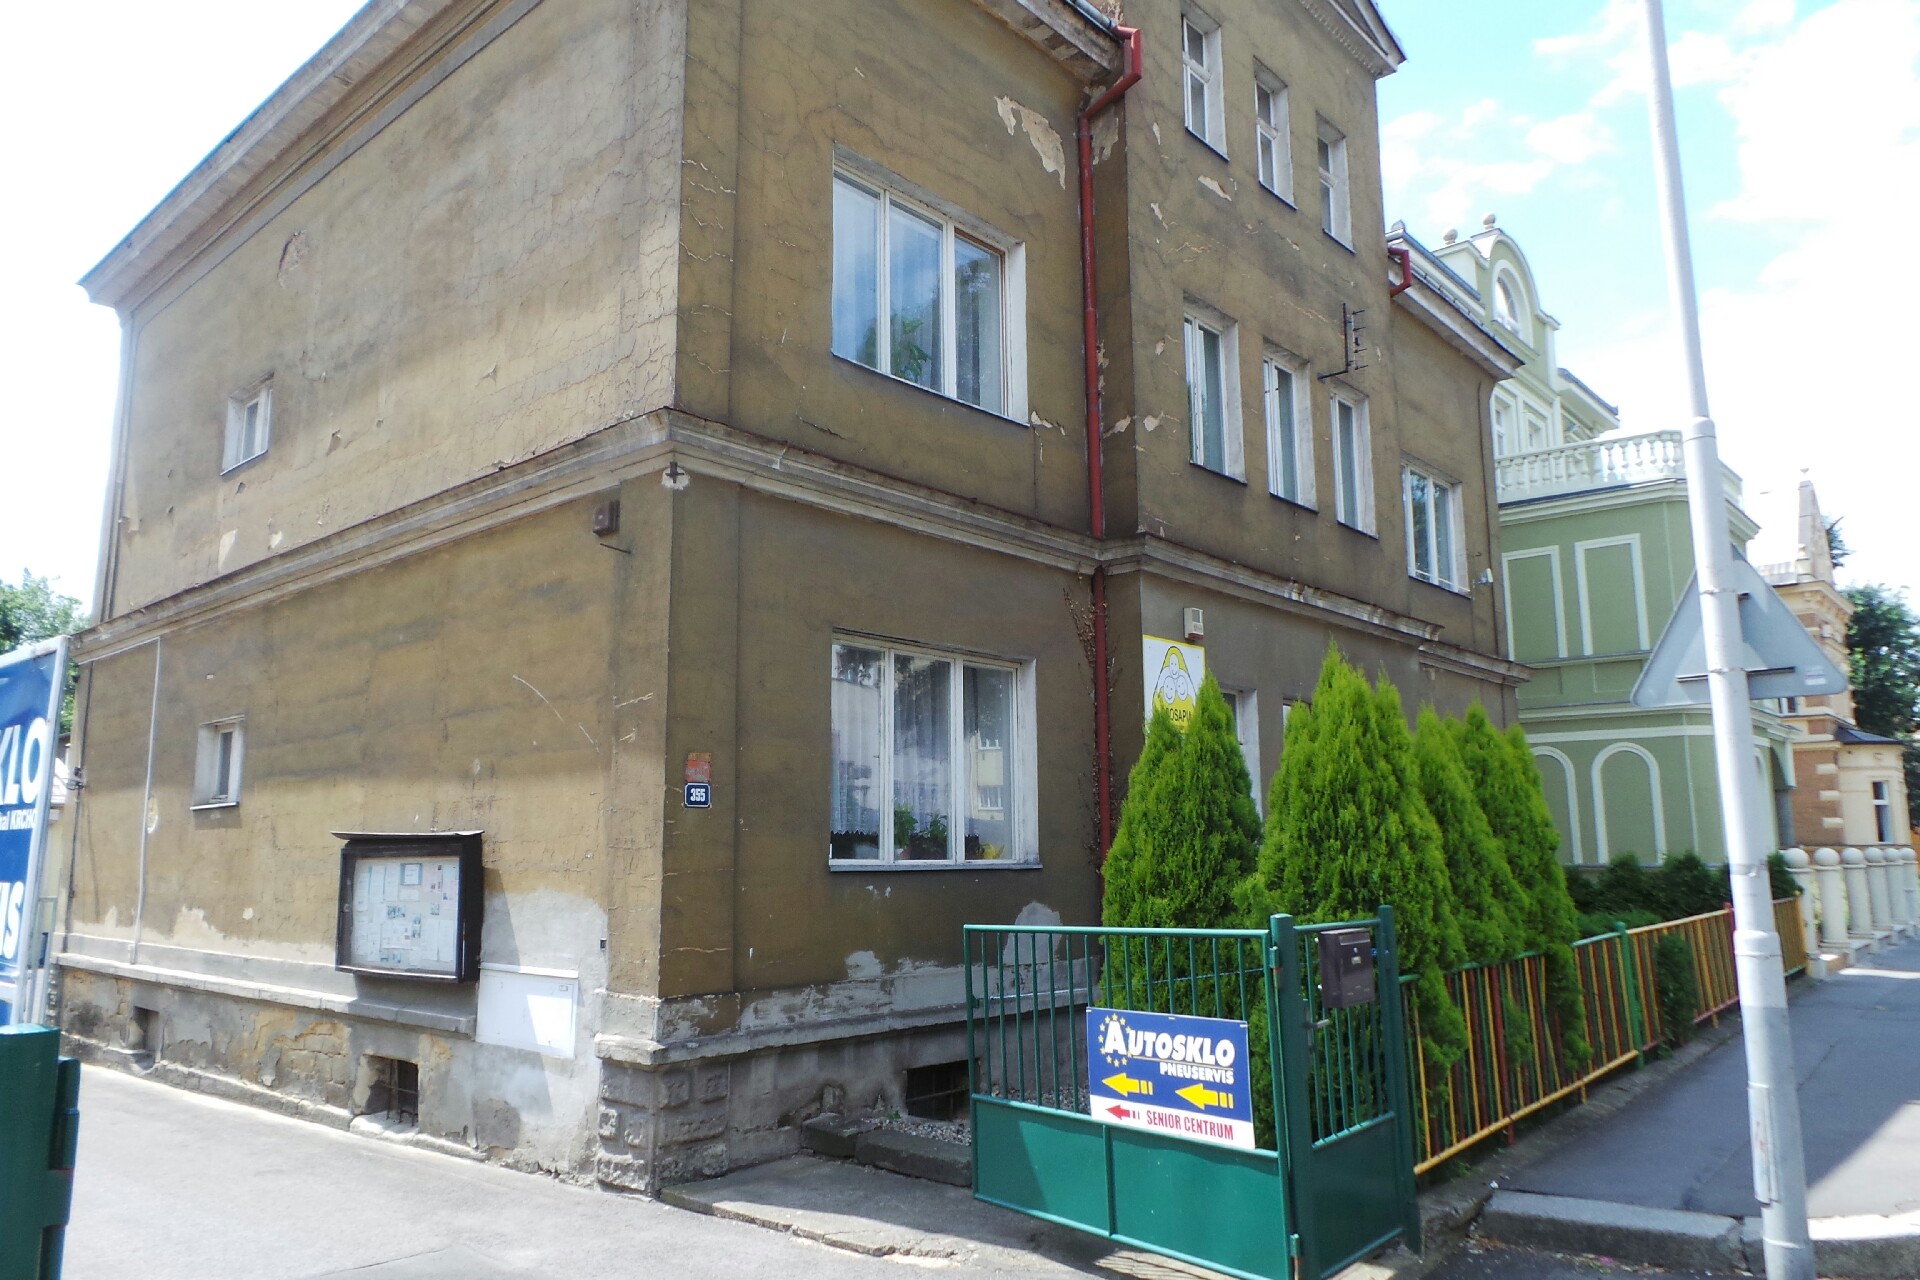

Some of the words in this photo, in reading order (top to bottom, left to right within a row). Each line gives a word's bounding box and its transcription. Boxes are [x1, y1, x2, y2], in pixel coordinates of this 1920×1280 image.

[690, 788, 706, 802] 355
[0, 881, 24, 960] IS
[1104, 1020, 1236, 1067] AUTOSKLO
[1159, 1061, 1235, 1085] PNEUSERVIS
[1146, 1109, 1182, 1130] SENIOR
[1184, 1117, 1234, 1141] CENTRUM
